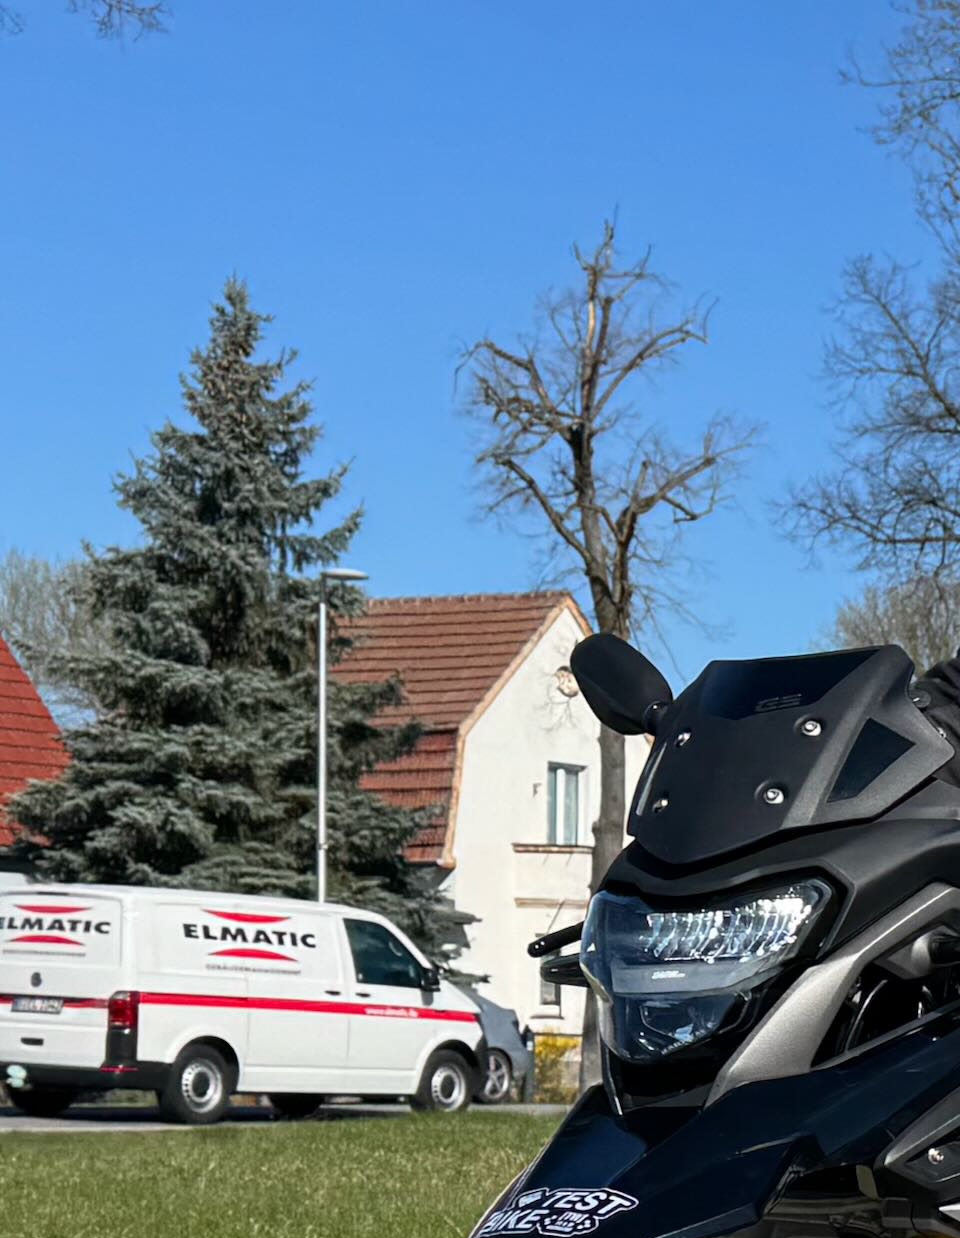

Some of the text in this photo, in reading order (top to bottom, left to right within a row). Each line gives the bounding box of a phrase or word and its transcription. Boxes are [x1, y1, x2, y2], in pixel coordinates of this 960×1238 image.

[182, 923, 317, 948] ELMATIC
[541, 1191, 632, 1215] TEST
[479, 1209, 549, 1232] BIKE
